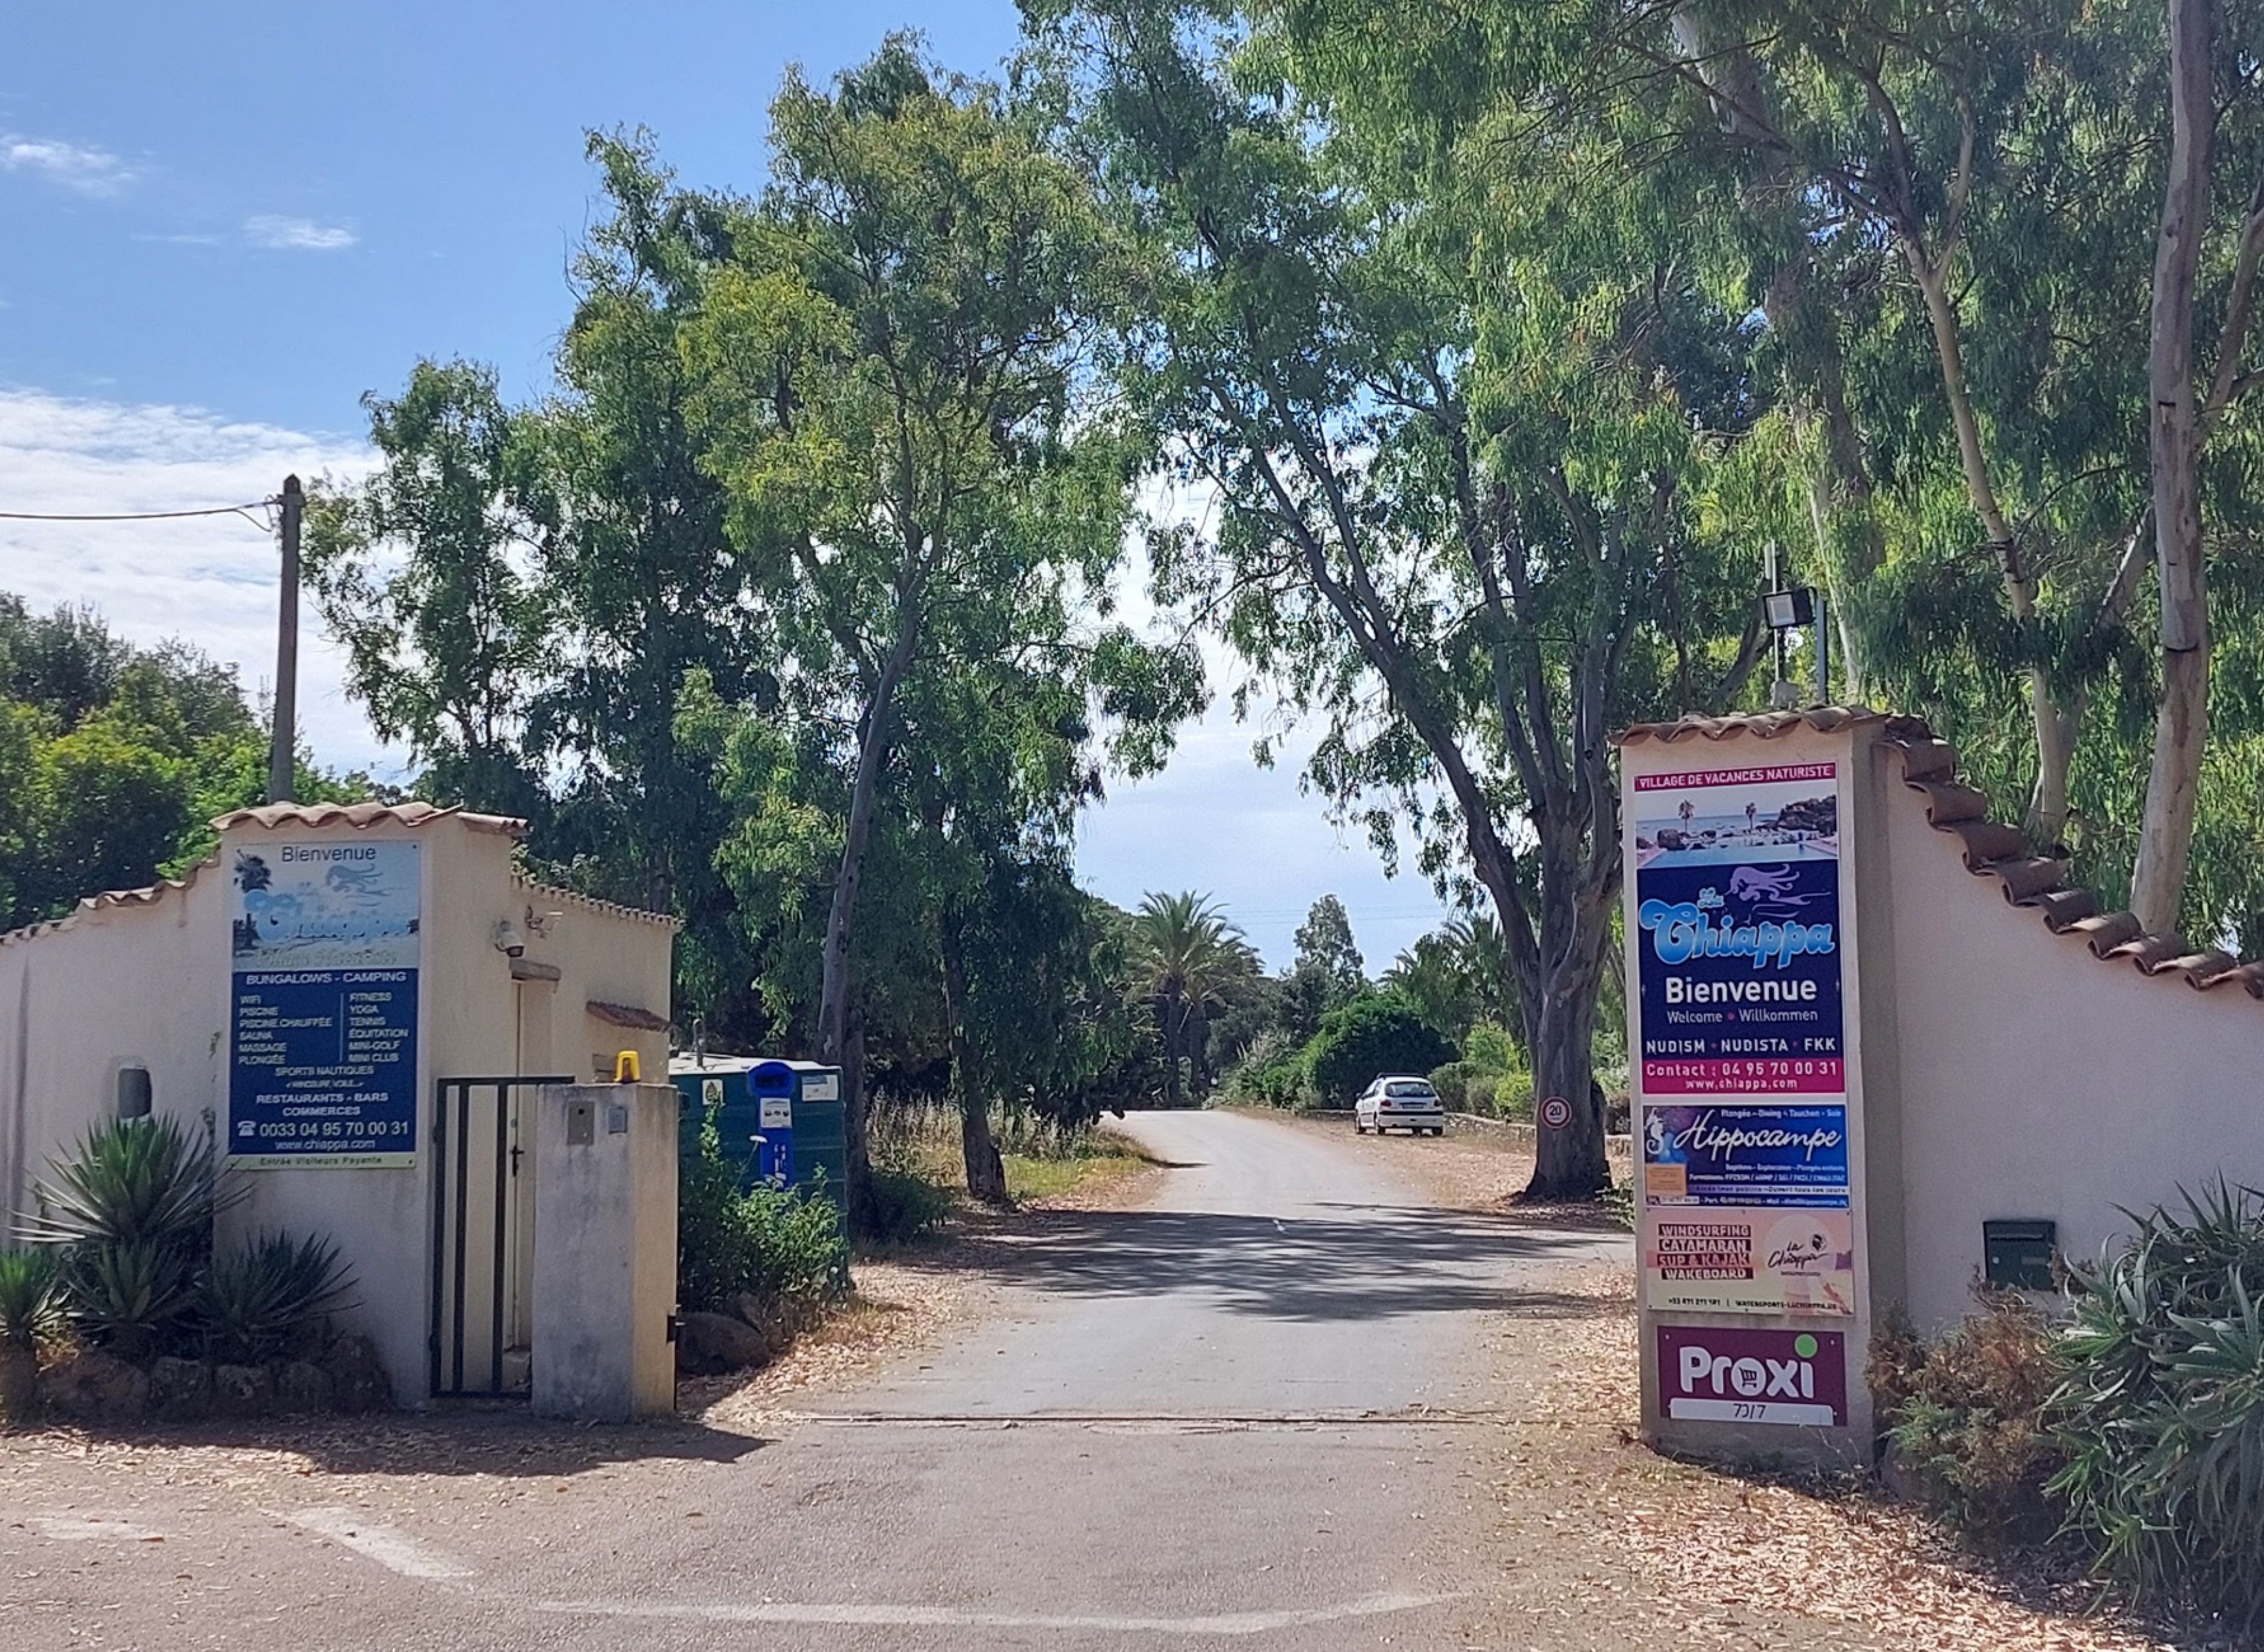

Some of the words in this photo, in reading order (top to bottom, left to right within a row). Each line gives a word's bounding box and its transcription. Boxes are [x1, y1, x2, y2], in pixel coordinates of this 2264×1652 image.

[1639, 775, 1686, 788] VILLAGE
[1688, 774, 1703, 786] DE
[1705, 770, 1763, 784] VACANCES
[1766, 765, 1831, 779] NATURISTE
[281, 846, 376, 862] Bienvenue
[1639, 898, 1835, 969] Chiappa
[246, 973, 332, 985] BUNGALOWS
[343, 972, 406, 983] CAMPING
[1666, 977, 1817, 1003] Bienvenue
[349, 992, 392, 1002] FITNESS
[239, 1006, 279, 1017] PISCINE
[349, 1005, 379, 1014] YOGA
[1666, 1010, 1723, 1024] Welcome
[1738, 1008, 1819, 1023] Willkommen
[239, 1019, 278, 1029] PISCINE
[349, 1016, 387, 1026] TENNIS
[239, 1031, 274, 1040] SAUNA
[239, 1042, 288, 1053] MASSAGE
[1645, 1038, 1705, 1055] NUDISM
[1721, 1037, 1789, 1052] NUDISTA
[1804, 1037, 1836, 1051] FKK
[371, 1052, 400, 1062] CLUB
[275, 1066, 315, 1076] SPORTS
[316, 1065, 374, 1075] NAUTIQUES
[1646, 1062, 1706, 1077] Contact
[1722, 1062, 1741, 1076] 04
[1746, 1062, 1765, 1076] 95
[1770, 1061, 1789, 1075] 70
[1795, 1061, 1813, 1075] 00
[1819, 1061, 1838, 1076] 31
[1685, 1077, 1798, 1090] www.chiappa.com
[255, 1093, 344, 1104] RESTAURANTS
[353, 1092, 389, 1102] BARS
[282, 1106, 361, 1117] COMMERCES
[1549, 1104, 1562, 1117] 20
[259, 1123, 296, 1137] 0033
[299, 1123, 318, 1136] 04
[322, 1122, 341, 1136] 95
[345, 1122, 364, 1136] 70
[368, 1121, 387, 1135] 00
[390, 1120, 409, 1134] 31
[1672, 1109, 1842, 1161] Hippocampe
[275, 1139, 376, 1152] www.chiappa.com
[1661, 1225, 1749, 1237] WINDSURFING
[1661, 1238, 1747, 1252] CATAMARAN
[1658, 1254, 1686, 1265] SUP
[1702, 1253, 1749, 1265] KAJAK
[1664, 1268, 1748, 1279] WAKEBOARD
[1679, 1333, 1819, 1399] Proxi
